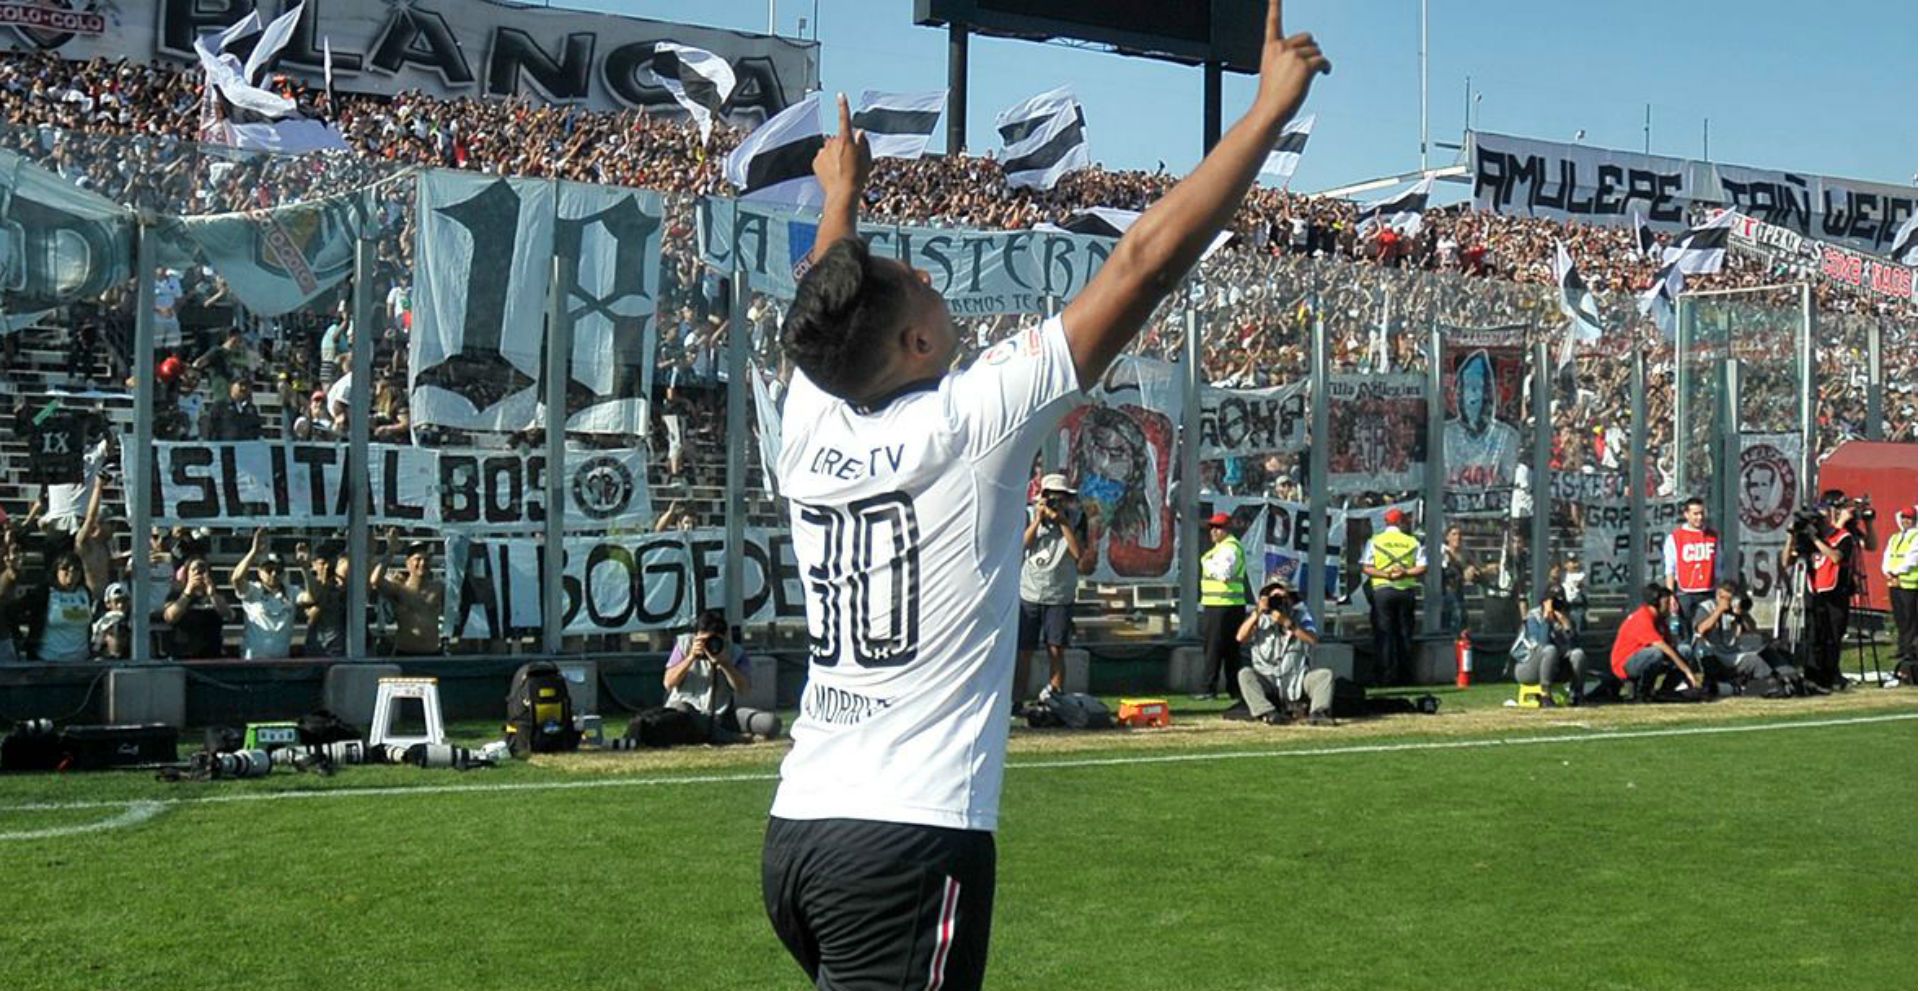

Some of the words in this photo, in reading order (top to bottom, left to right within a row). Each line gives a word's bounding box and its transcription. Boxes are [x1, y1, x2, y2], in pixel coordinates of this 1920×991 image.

[0, 5, 103, 31] OLO-COLO
[1474, 144, 1682, 218] AMULEPE
[1682, 541, 1716, 563] CDF
[800, 489, 921, 669] 30
